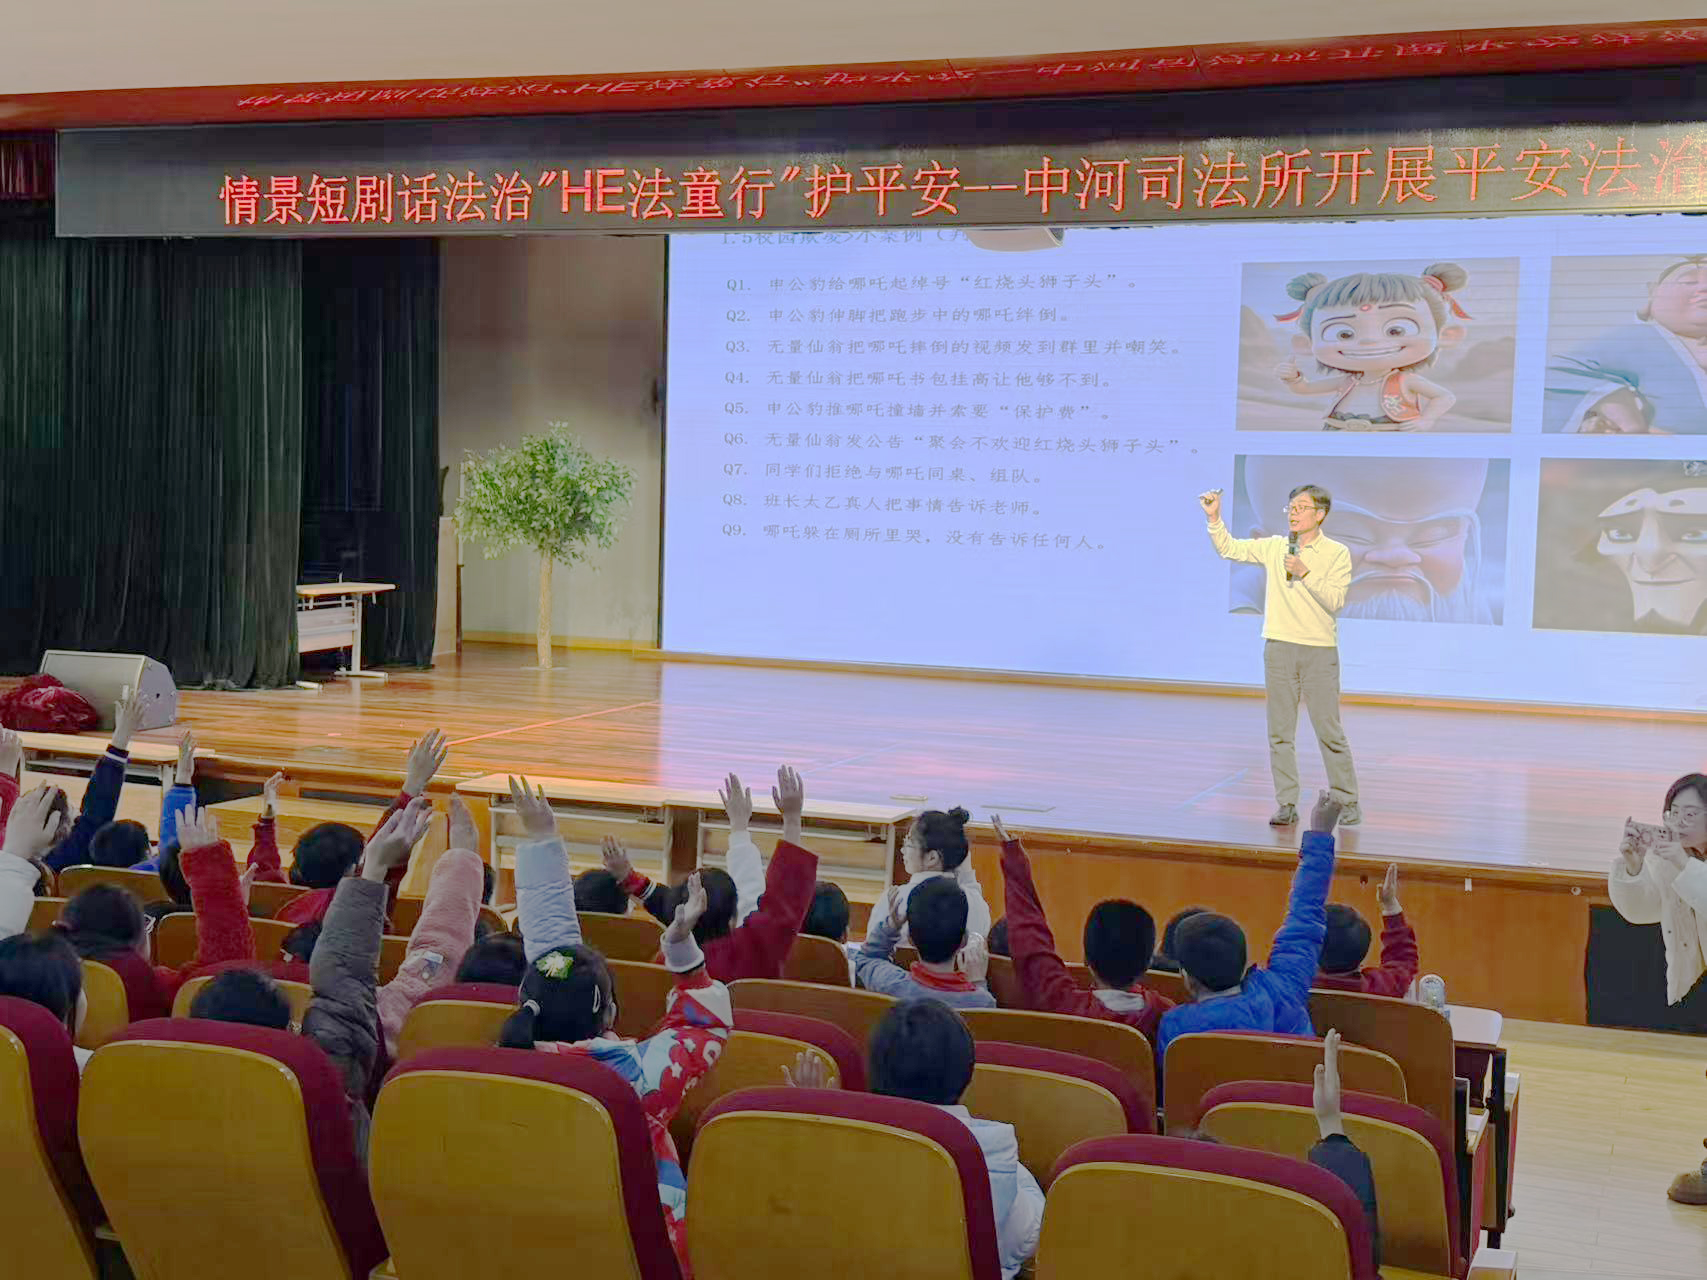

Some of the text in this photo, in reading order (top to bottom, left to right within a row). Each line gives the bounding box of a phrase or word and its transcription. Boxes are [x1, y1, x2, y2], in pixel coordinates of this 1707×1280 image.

[726, 279, 752, 292] Q1.
[726, 310, 751, 322] Q2.
[726, 340, 751, 353] Q3.
[725, 371, 750, 384] Q4.
[724, 402, 749, 415] Q5.
[724, 432, 748, 446] Q6.
[723, 463, 748, 476] Q7.
[722, 494, 747, 507] Q8.
[722, 524, 746, 537] Q9.
